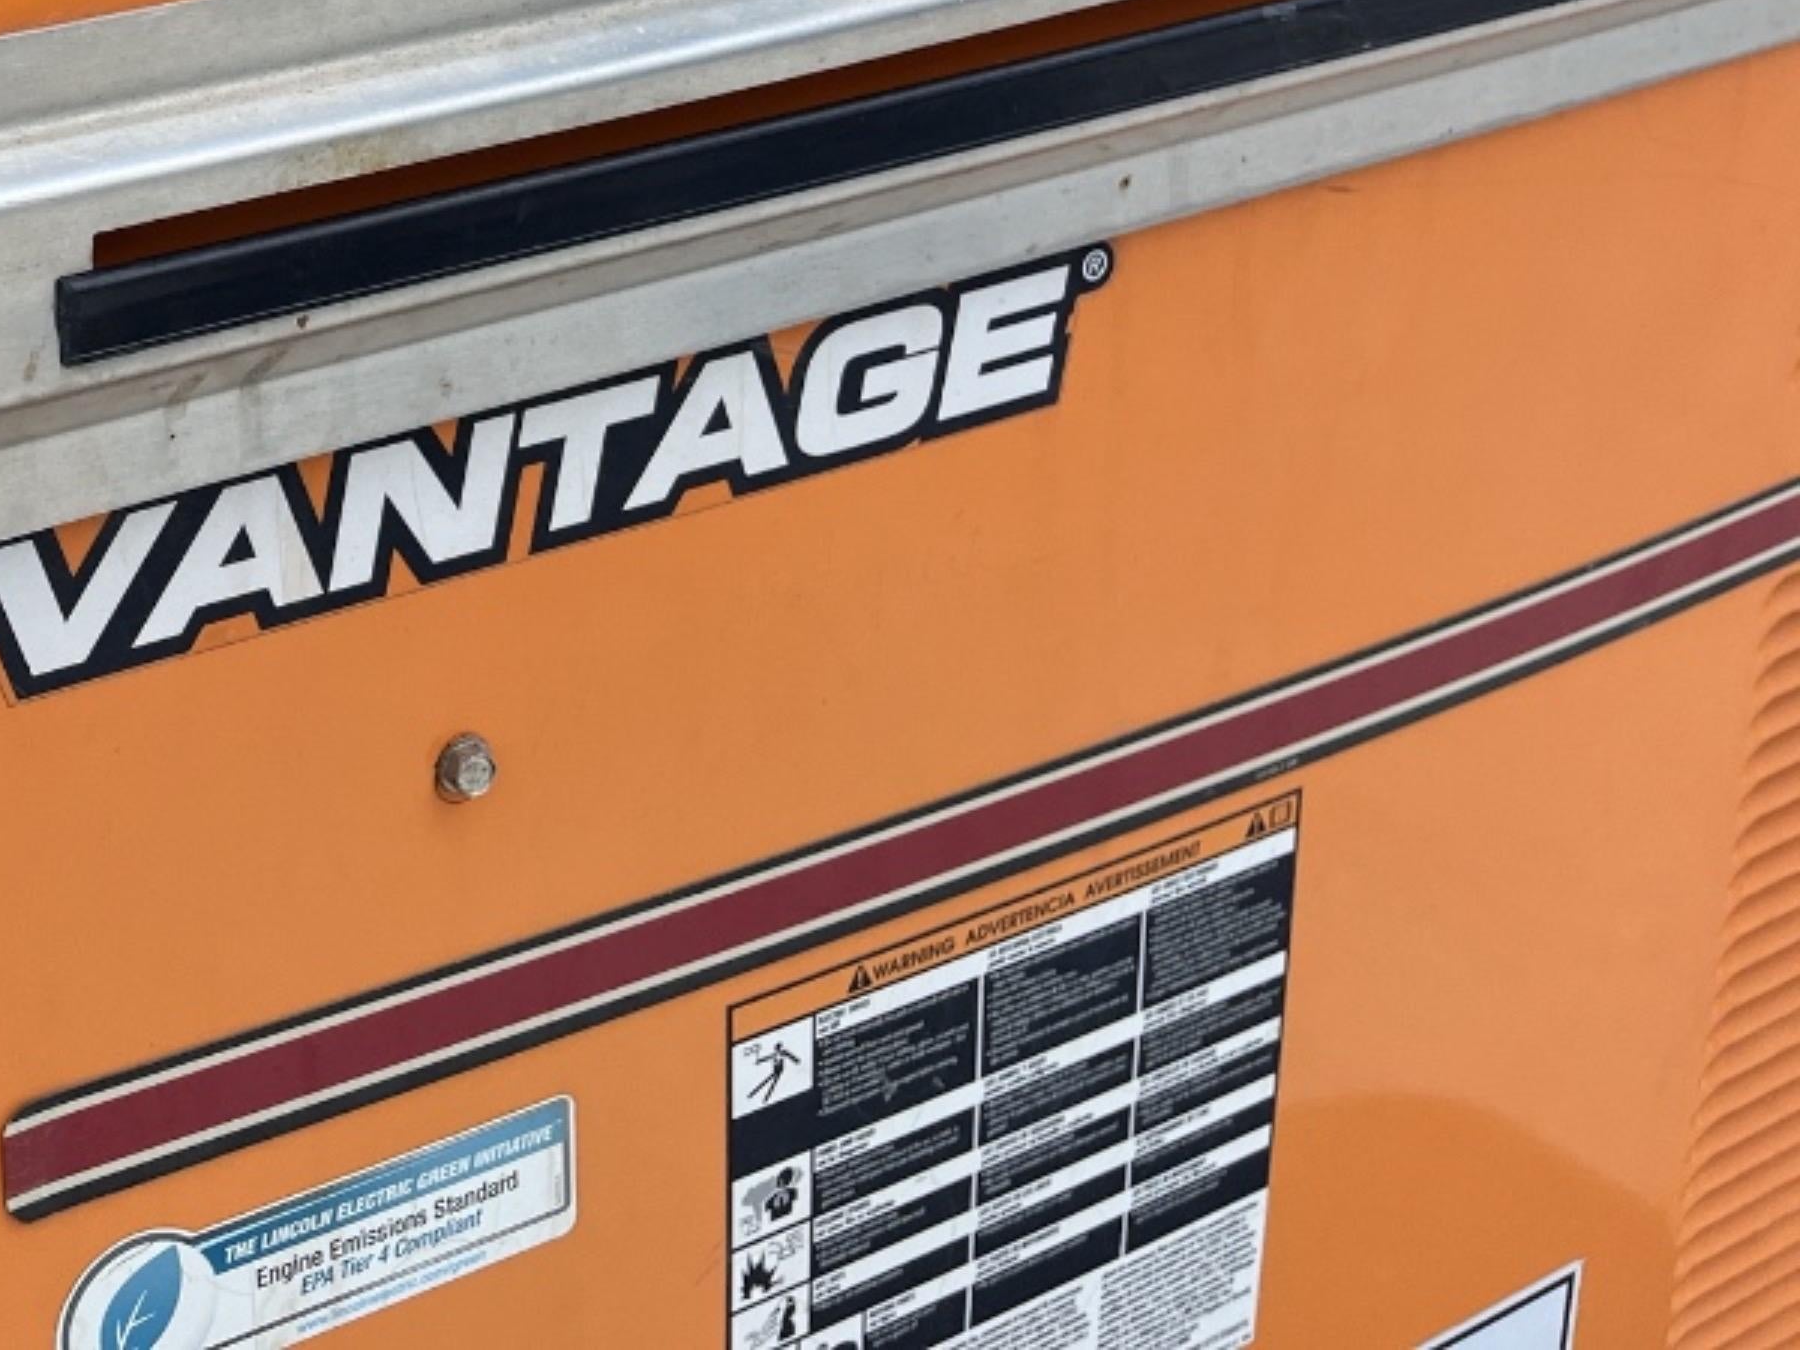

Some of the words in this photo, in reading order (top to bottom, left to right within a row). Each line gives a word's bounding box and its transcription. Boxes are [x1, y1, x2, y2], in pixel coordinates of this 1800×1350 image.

[872, 936, 957, 981] WARNING
[965, 891, 1075, 945] ADVERTENCIA
[1085, 840, 1203, 899] AVERTISSEMENT
[225, 1235, 259, 1265] THE
[261, 1207, 334, 1250] LINCOLN
[336, 1177, 413, 1222] ELECTRIC
[416, 1154, 472, 1192] GREEN
[473, 1123, 553, 1171] INITIATIVE
[256, 1248, 324, 1289] Engine
[329, 1207, 428, 1261] Emissions
[433, 1169, 520, 1219] Standard
[302, 1265, 335, 1296] EPA
[340, 1252, 375, 1280] Tier
[377, 1243, 390, 1263] 4
[394, 1208, 484, 1260] Compliant
